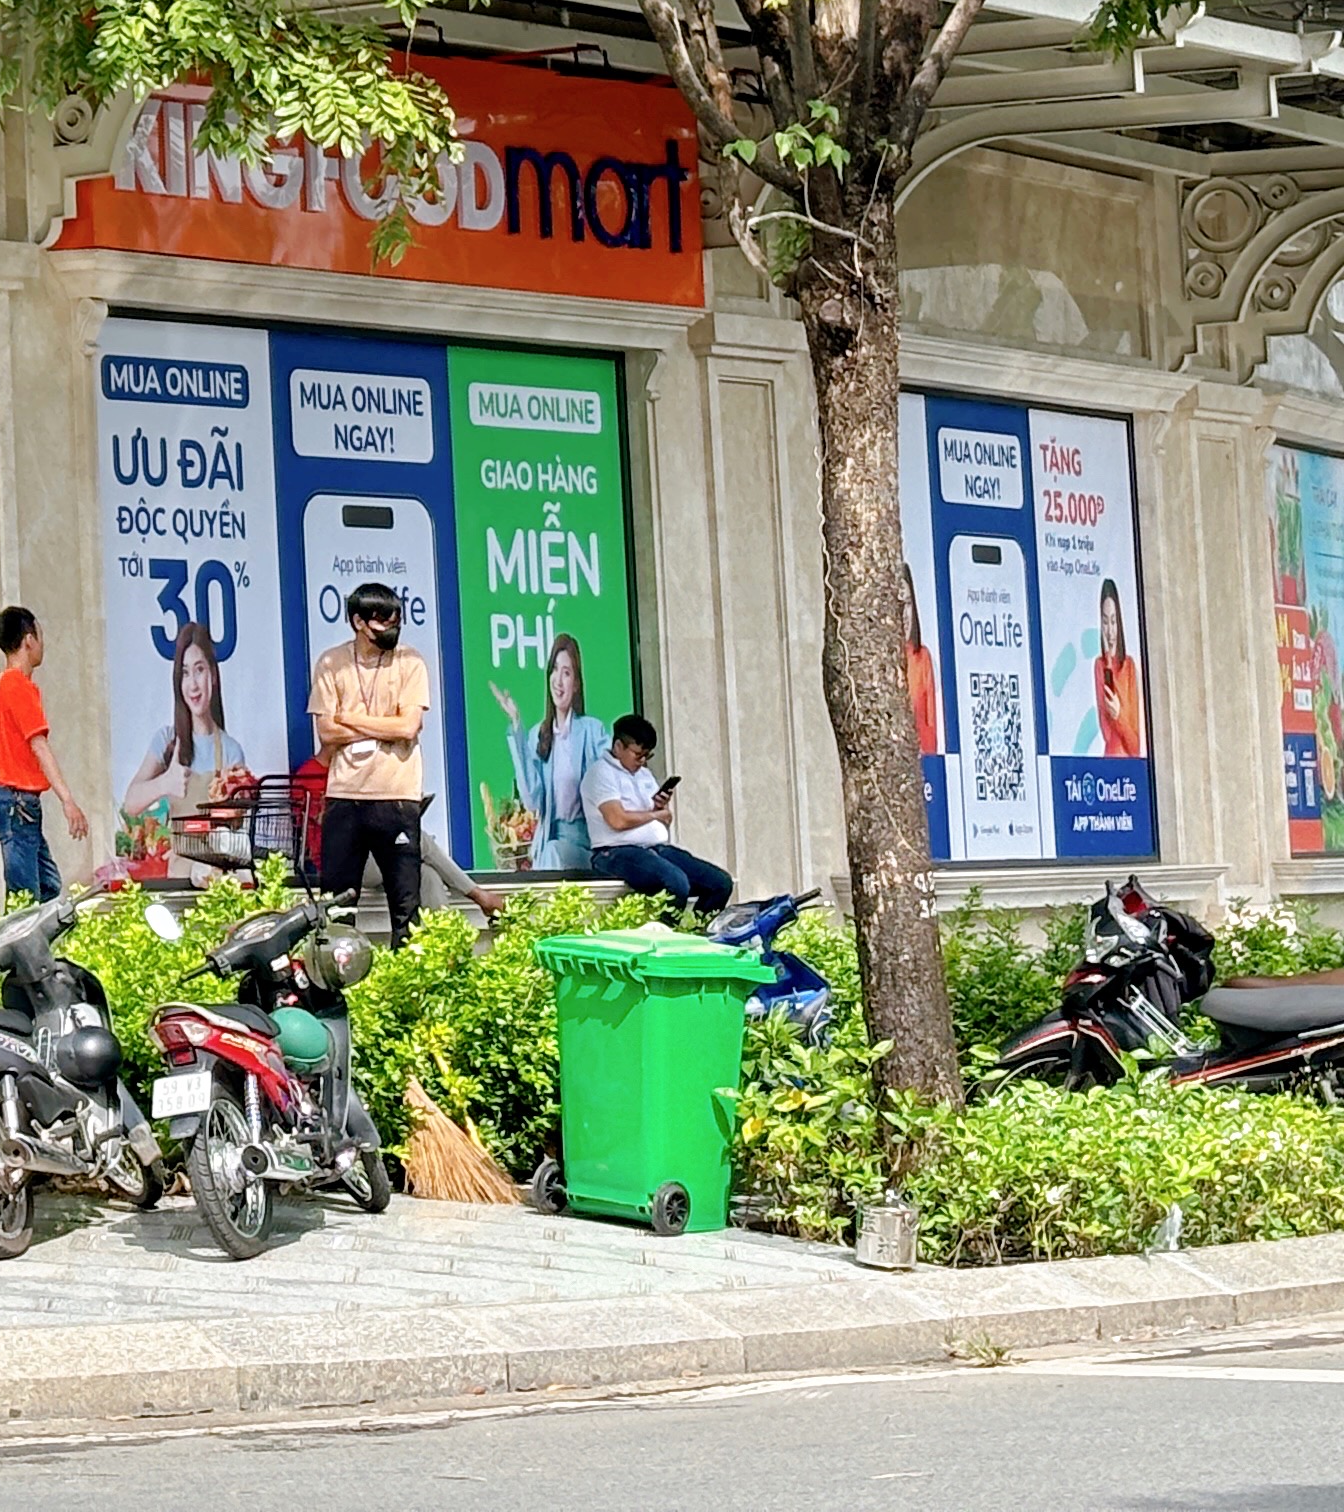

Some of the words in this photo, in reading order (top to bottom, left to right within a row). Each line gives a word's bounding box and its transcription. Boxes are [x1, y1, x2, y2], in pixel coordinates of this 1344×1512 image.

[110, 363, 161, 395] MUA
[165, 367, 243, 401] ONLINE
[299, 381, 347, 411] MUA
[351, 385, 424, 417] ONLINE
[478, 390, 523, 420] MUA
[527, 395, 595, 425] ONLINE
[334, 423, 395, 454] NGAY!
[943, 438, 972, 463] MUA
[974, 441, 1018, 469] ONLINE
[112, 427, 168, 488] ƯU
[177, 426, 244, 491] ĐÃI
[480, 458, 533, 491] GIAO
[537, 454, 598, 495] HÀNG
[1039, 436, 1082, 483] TẶNG
[964, 474, 1001, 500] NGAY!
[116, 498, 167, 544] ĐỘC
[172, 499, 246, 544] QUYỀN
[118, 551, 143, 578] TỚI
[332, 554, 354, 577] App
[355, 553, 384, 574] thành
[486, 501, 601, 598] MIỄN
[490, 597, 555, 671] PHÍ
[960, 611, 1023, 649] OneLife
[1096, 777, 1137, 803] OneLife
